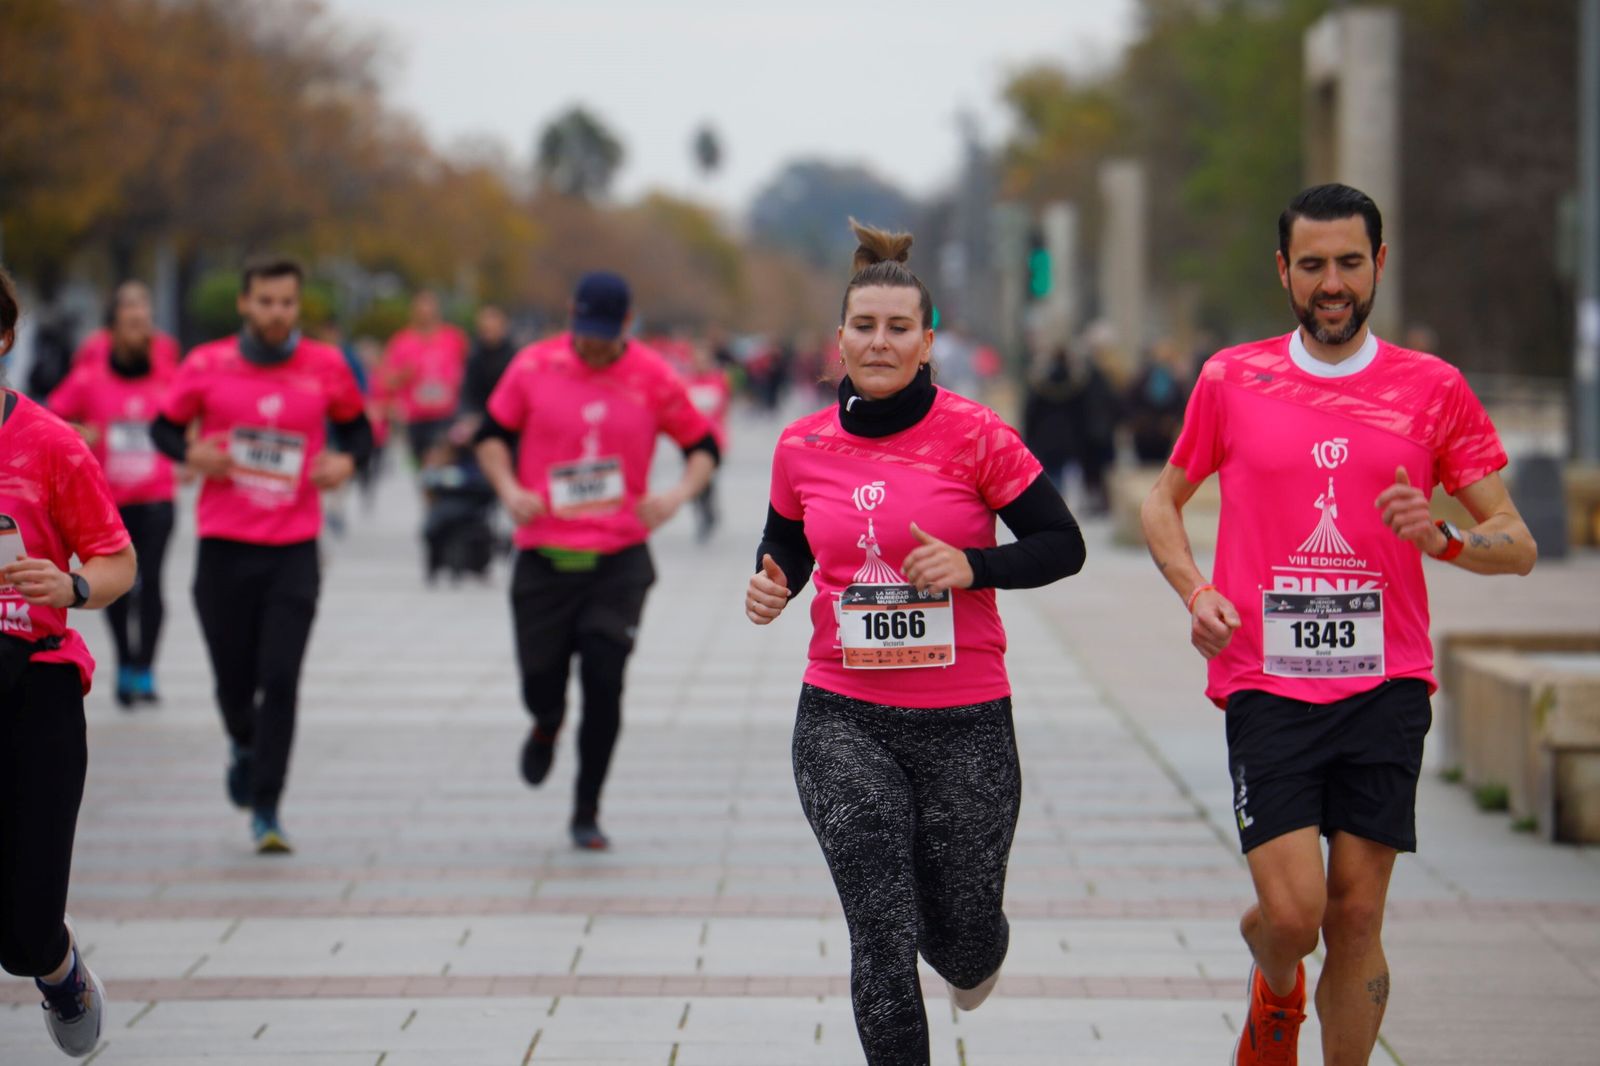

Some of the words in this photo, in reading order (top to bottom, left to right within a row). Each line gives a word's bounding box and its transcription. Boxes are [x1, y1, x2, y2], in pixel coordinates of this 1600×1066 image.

[1288, 555, 1307, 566] VIII
[1311, 555, 1367, 568] EDICIÓN
[862, 610, 926, 641] 1666
[1290, 620, 1356, 649] 1343
